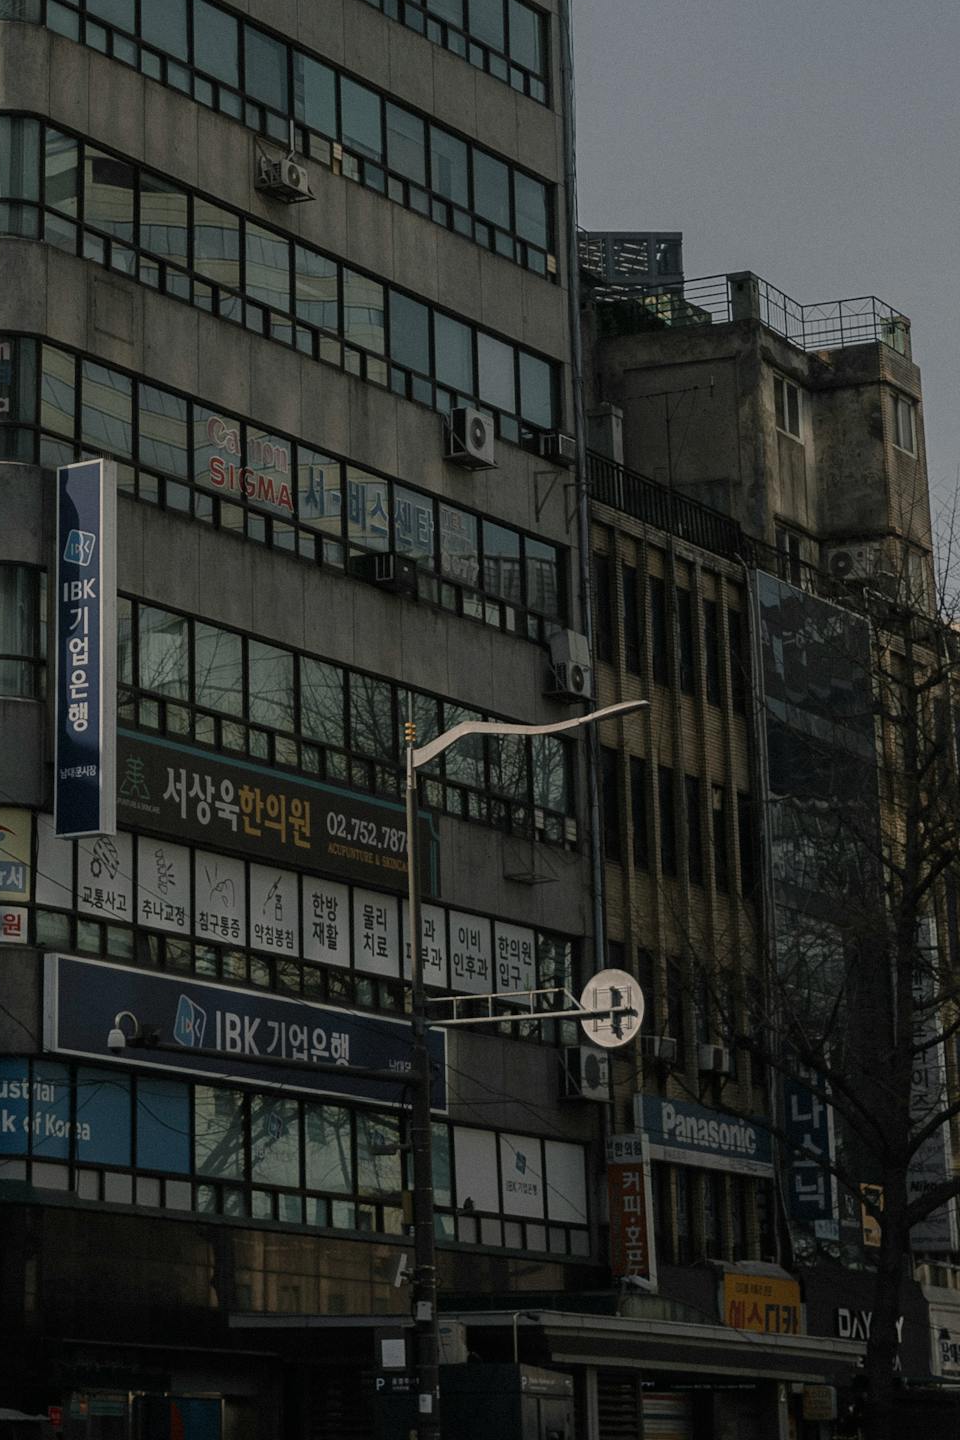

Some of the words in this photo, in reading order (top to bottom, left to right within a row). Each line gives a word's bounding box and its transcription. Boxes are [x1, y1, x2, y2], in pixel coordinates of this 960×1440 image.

[207, 416, 289, 474] Canon
[208, 456, 297, 515] SIGMA
[63, 577, 97, 603] IBK
[68, 606, 90, 733] 기업은행
[59, 764, 97, 780] 남대문시장
[326, 810, 409, 854] 02.752.787
[81, 886, 128, 913] 교통사고
[141, 898, 185, 927] 추나교정
[311, 891, 338, 922] 한방
[198, 911, 241, 939] 침구통증
[362, 904, 387, 932] 물리
[253, 923, 295, 950] 약침봉침
[312, 921, 339, 951] 재활
[363, 931, 389, 958] 치료
[458, 927, 482, 953] 이비
[497, 935, 533, 966] 한의원
[453, 952, 489, 981] 인후과
[498, 963, 523, 990] 입구
[22, 1111, 43, 1136] of
[45, 1113, 91, 1141] Korea
[660, 1102, 758, 1155] Panasonic
